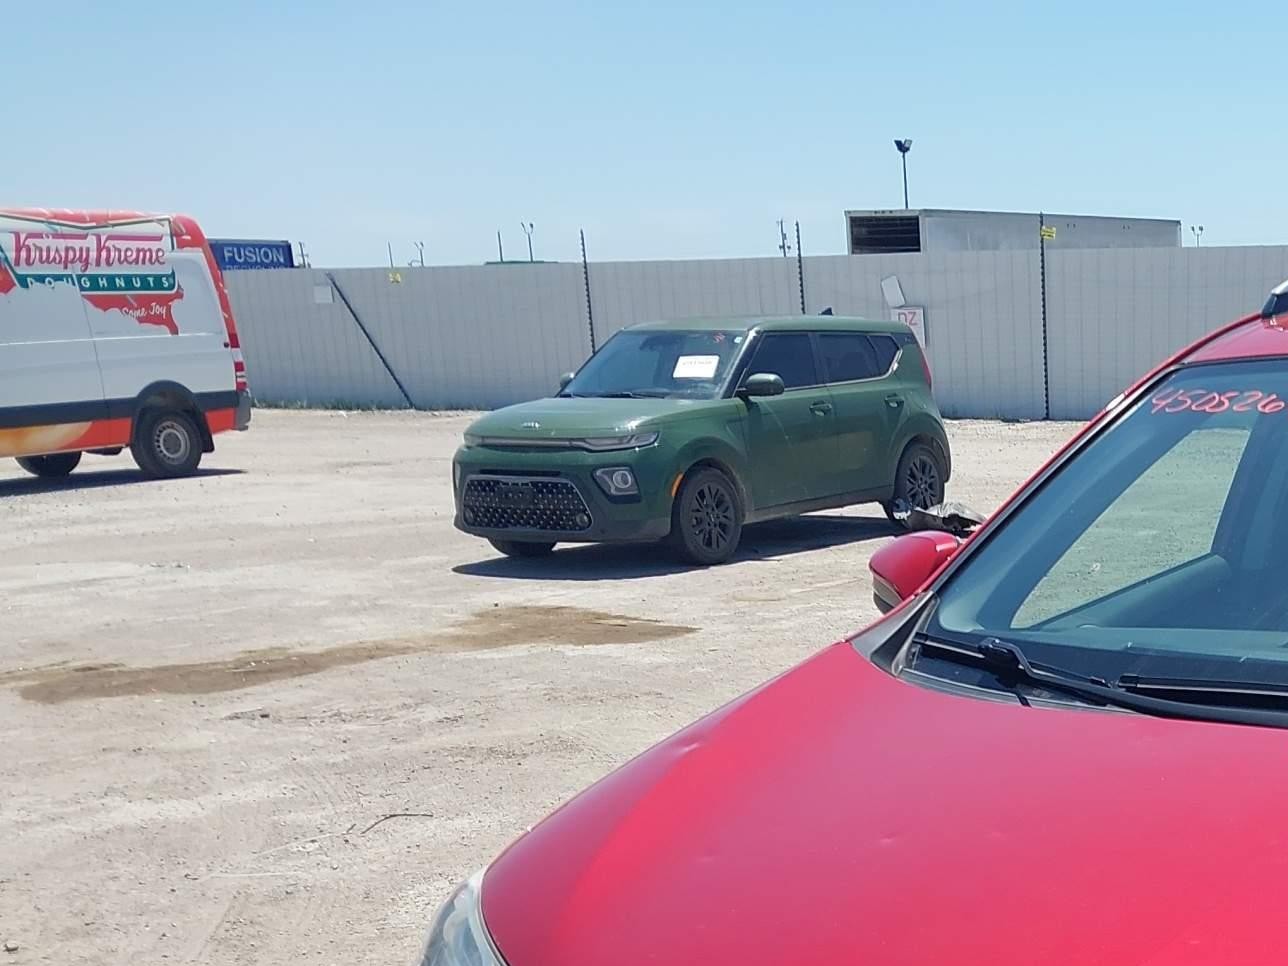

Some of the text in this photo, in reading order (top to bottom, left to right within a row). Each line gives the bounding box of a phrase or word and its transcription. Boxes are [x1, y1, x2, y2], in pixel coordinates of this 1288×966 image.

[10, 231, 166, 272] Krispy Kreme
[223, 246, 285, 263] FUSION
